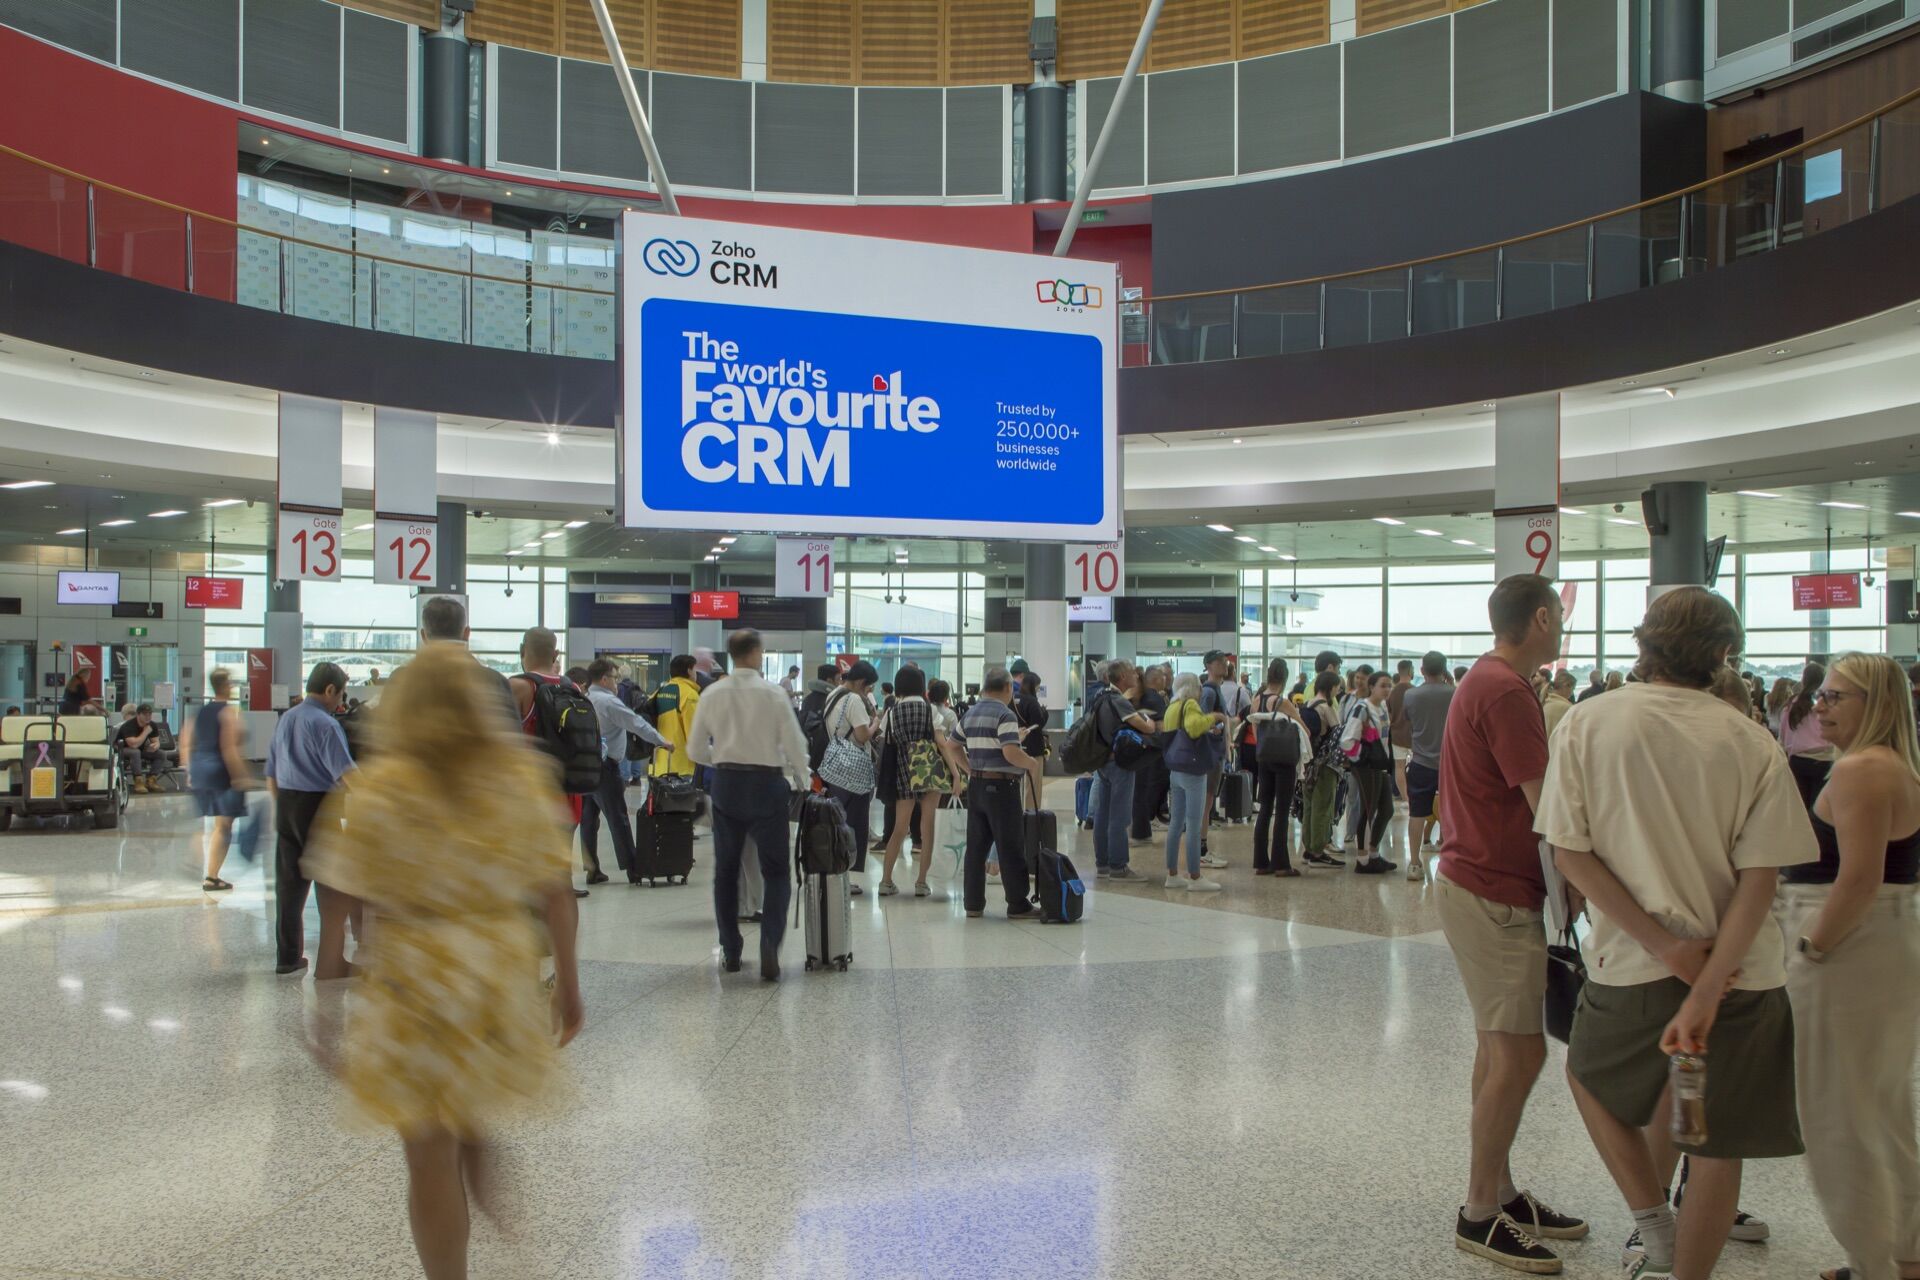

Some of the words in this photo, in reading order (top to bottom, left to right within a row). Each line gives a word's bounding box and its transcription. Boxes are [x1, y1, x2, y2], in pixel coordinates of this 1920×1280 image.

[711, 240, 756, 258] Zoho
[710, 260, 777, 289] CRM
[682, 331, 739, 361] The
[722, 358, 828, 388] world's
[682, 360, 940, 433] Favourite
[996, 402, 1040, 416] Trusted
[1042, 404, 1056, 419] by
[996, 420, 1080, 440] 250,000+
[681, 421, 850, 487] CRM
[996, 441, 1060, 456] businesses
[996, 458, 1057, 471] worldwide
[313, 517, 337, 529] Gate
[408, 525, 432, 536] Gate
[1527, 517, 1552, 528] Gate
[292, 529, 337, 577] 13
[807, 543, 829, 551] Gate
[1526, 530, 1552, 576] 9
[389, 536, 431, 581] 12
[797, 553, 829, 592] 11
[1075, 551, 1118, 592] 10
[187, 580, 199, 590] 12
[693, 594, 701, 604] 11
